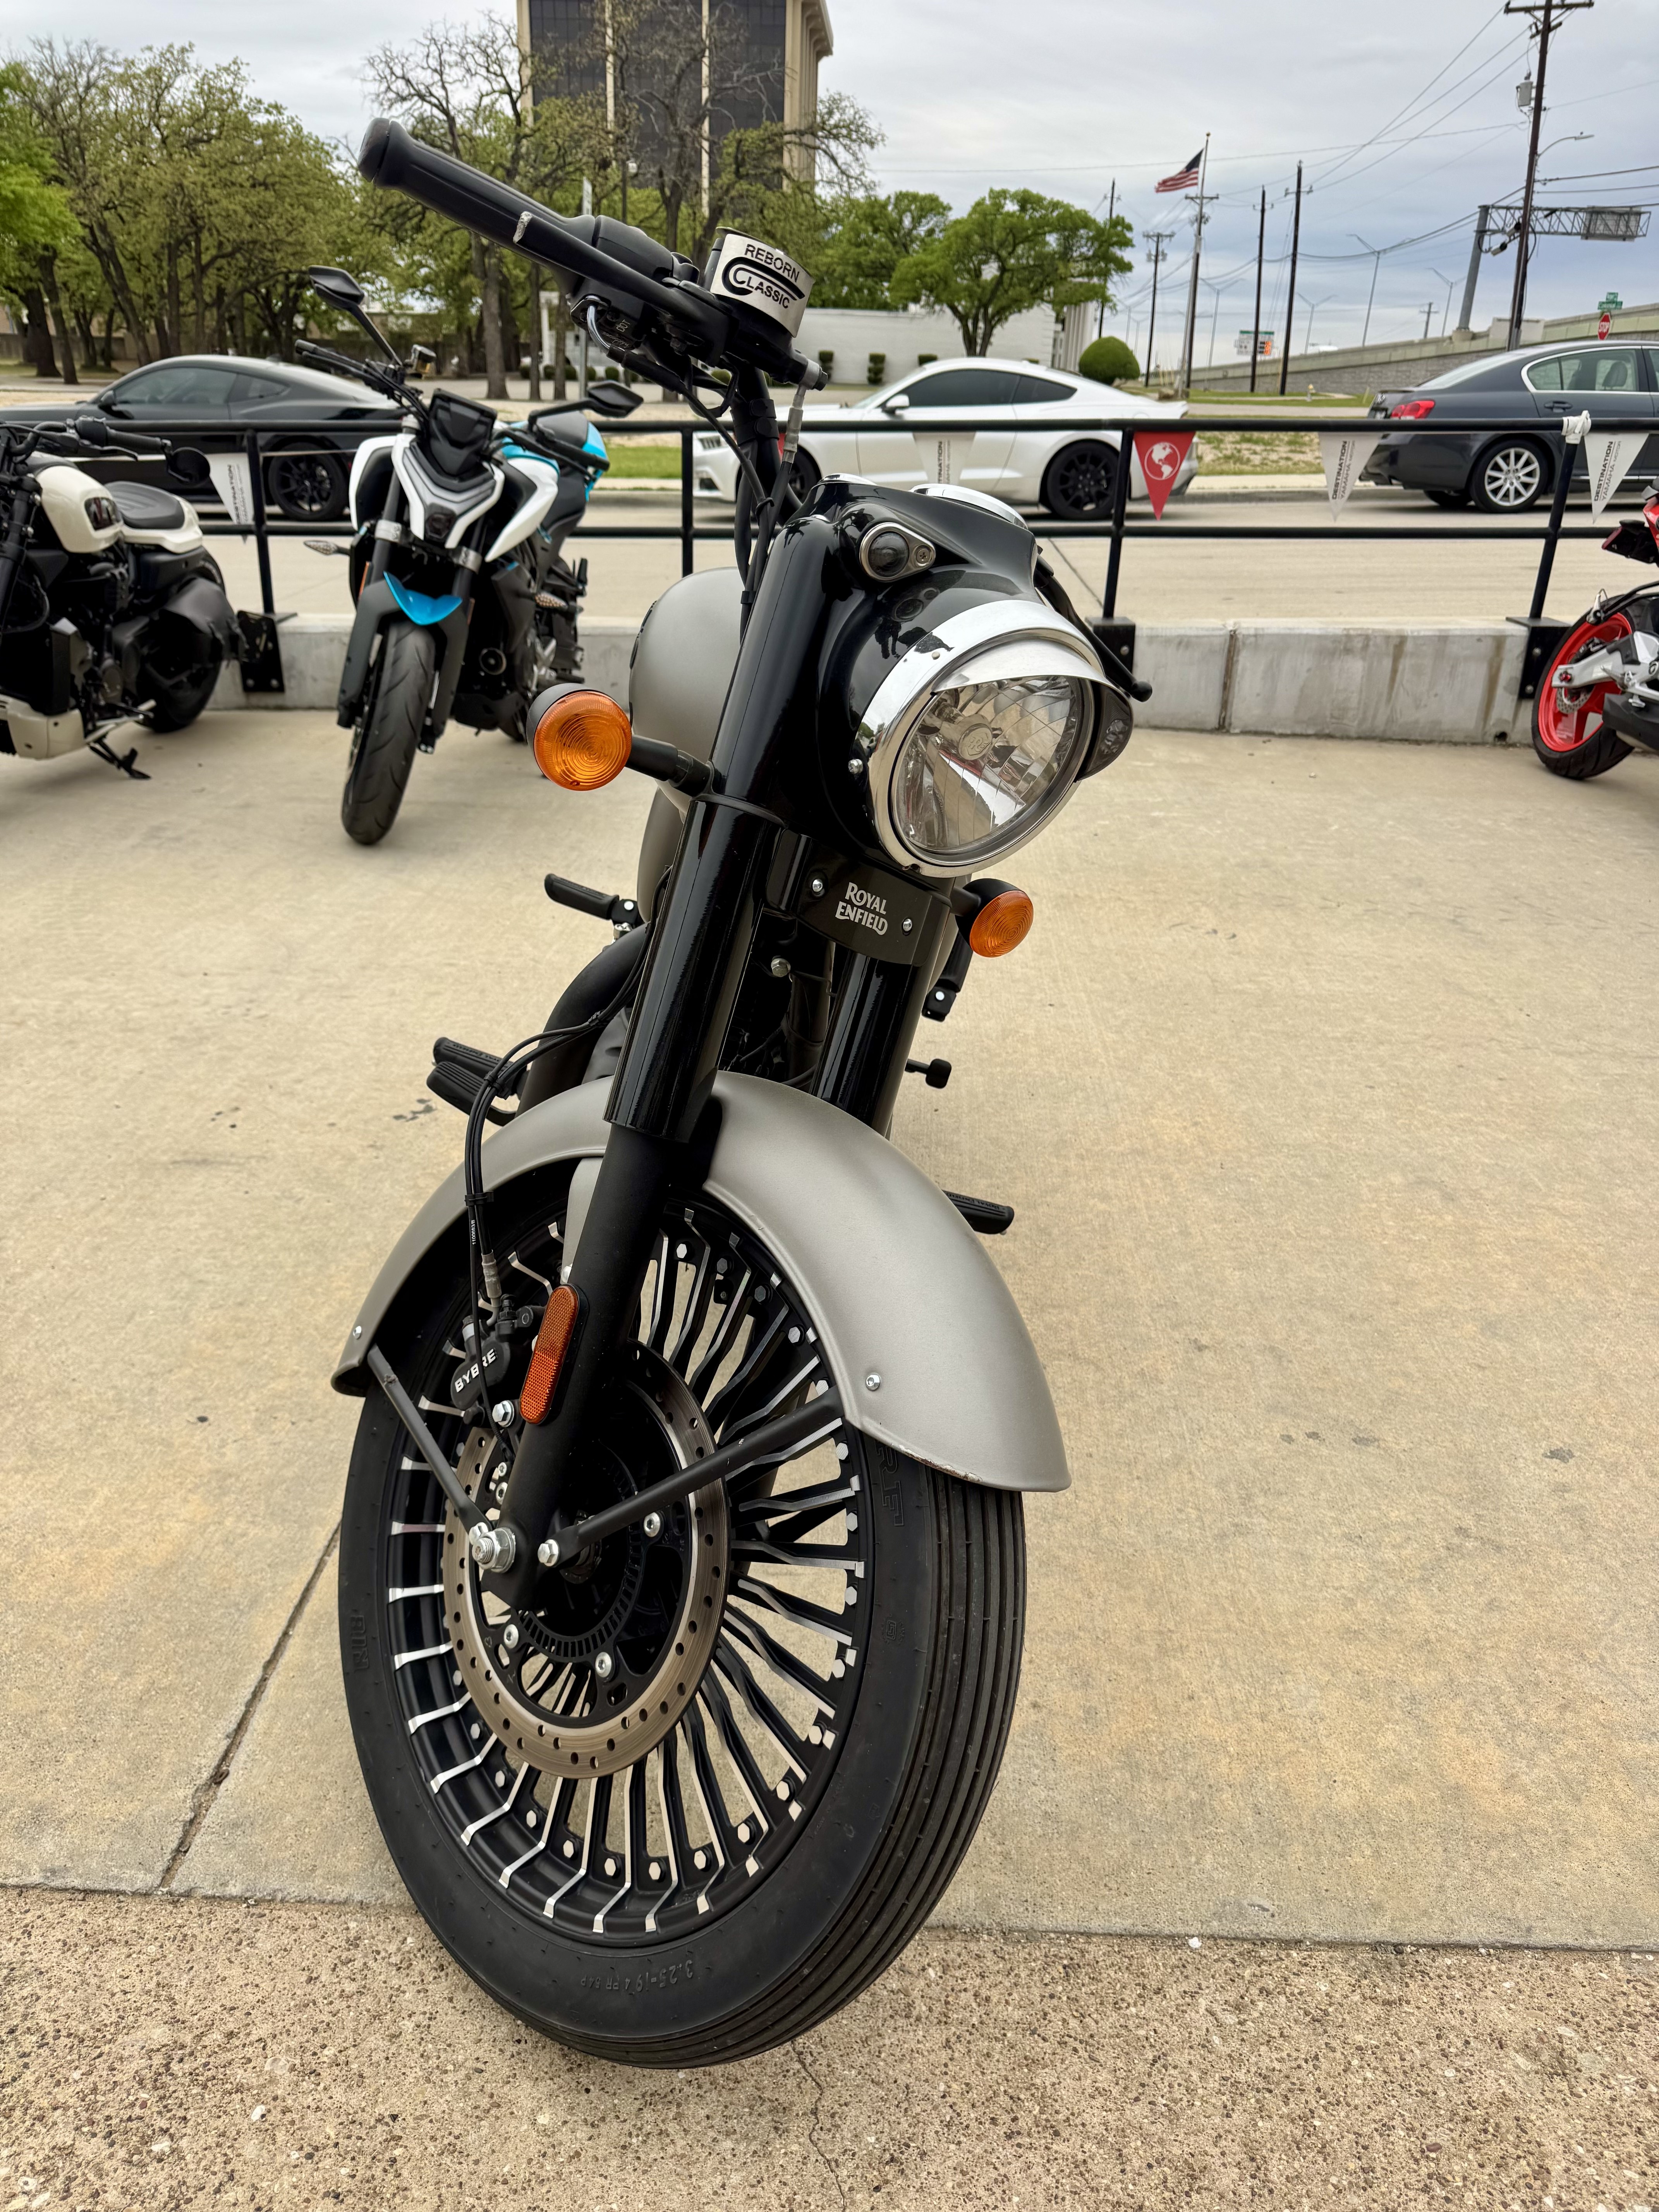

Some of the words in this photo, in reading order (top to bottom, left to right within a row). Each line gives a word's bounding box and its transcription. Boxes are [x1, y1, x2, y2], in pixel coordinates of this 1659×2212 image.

[744, 244, 800, 283] REBORN
[733, 266, 790, 309] CLASSIC
[1332, 440, 1348, 500] DESTINATION
[1594, 441, 1613, 502] DESTINATION
[835, 901, 888, 936] ENFIELD
[845, 882, 887, 915] ROYAL
